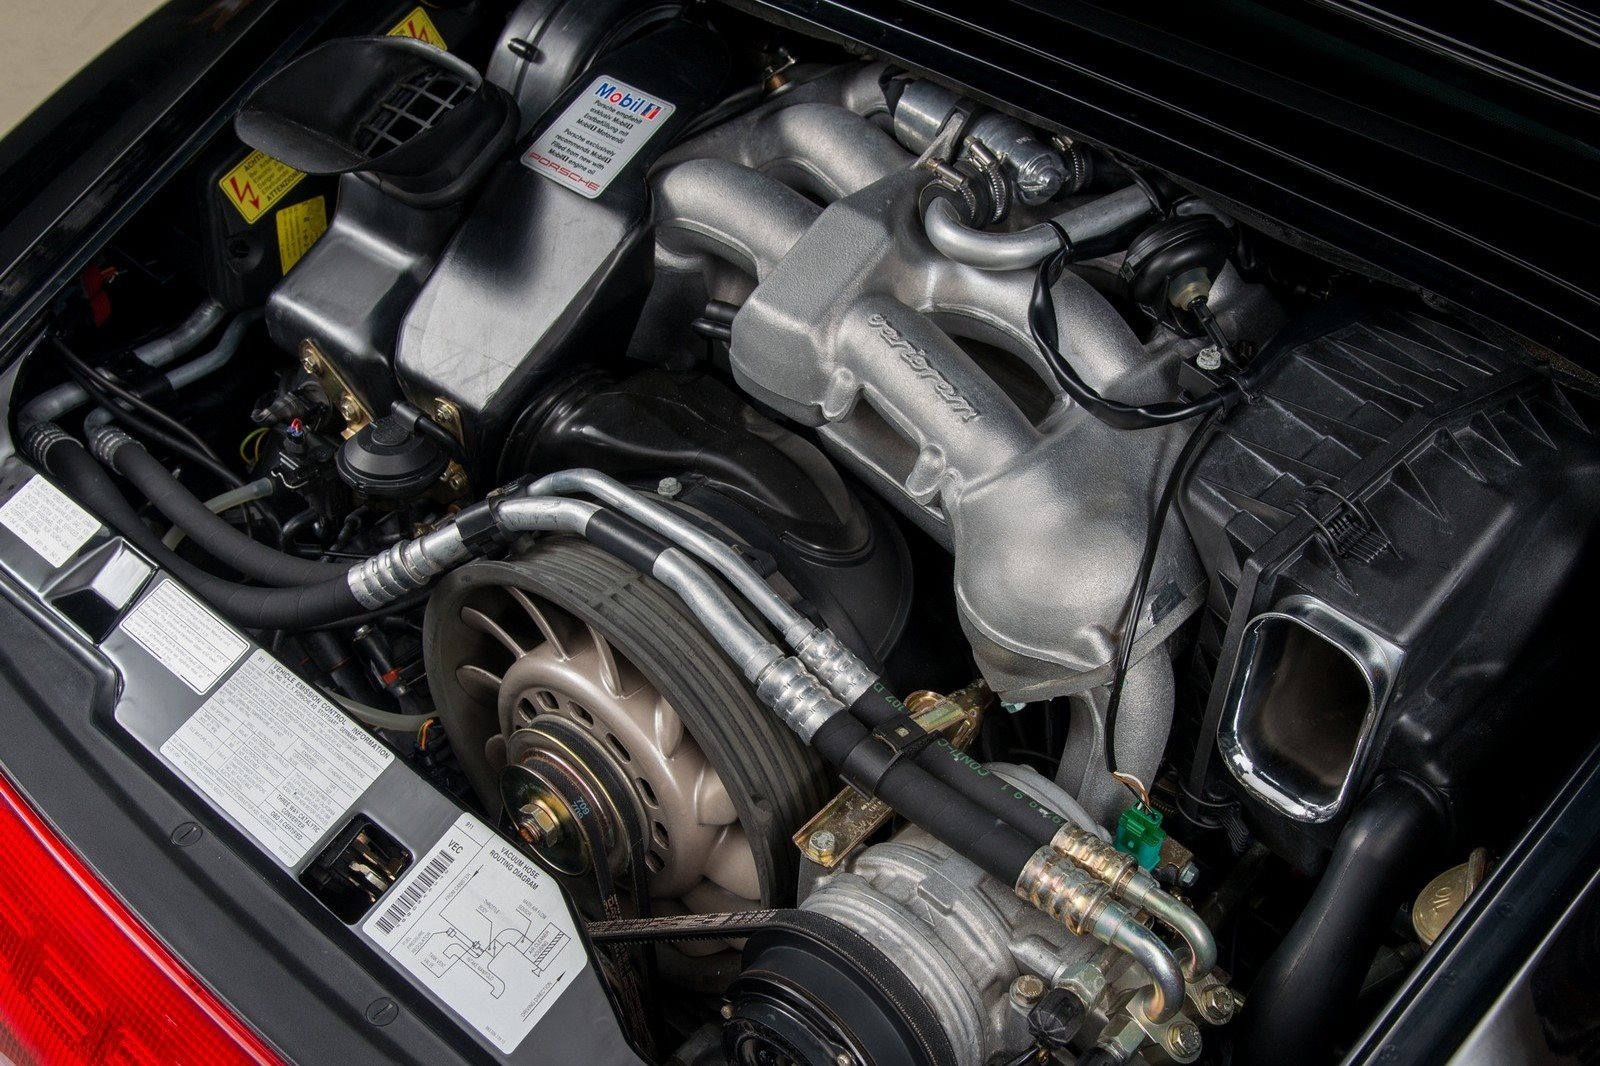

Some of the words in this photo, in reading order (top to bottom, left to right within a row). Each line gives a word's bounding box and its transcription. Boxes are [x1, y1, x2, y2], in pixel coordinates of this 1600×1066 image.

[593, 82, 645, 113] Mobil
[593, 99, 617, 113] Porsche
[615, 109, 642, 125] empfiehlt
[589, 107, 612, 119] exklusiv
[554, 134, 590, 154] recommends
[562, 127, 587, 142] Porsche
[584, 138, 616, 157] exclusively
[595, 128, 625, 144] Motorenöl
[618, 129, 629, 137] mit
[549, 140, 567, 151] Filled
[565, 147, 580, 158] from
[578, 154, 592, 163] new
[591, 160, 605, 170] with
[566, 158, 588, 172] engine
[527, 151, 600, 191] PORSCHE
[272, 663, 296, 683] VEHICLE
[294, 681, 322, 704] EMISSION
[320, 702, 348, 725] CONTROL
[350, 726, 390, 759] INFORMATION
[338, 726, 358, 743] GERMANY
[937, 738, 990, 778] CONTI-C
[269, 810, 280, 821] OBD
[281, 820, 303, 841] CERTIFIED
[275, 794, 290, 807] THREE
[288, 805, 299, 815] WAY
[297, 812, 320, 834] CATALYTIC
[280, 807, 305, 829] CONVERTER
[464, 821, 474, 830] 911
[446, 838, 464, 855] VEC
[488, 848, 514, 872] ROUTING
[511, 866, 539, 891] DIAGRAM
[499, 845, 524, 868] VACUUM
[522, 863, 540, 880] HOSE
[1432, 886, 1453, 917] OIL
[520, 996, 537, 1020] DRIVING
[534, 977, 552, 1002] DIRECTION
